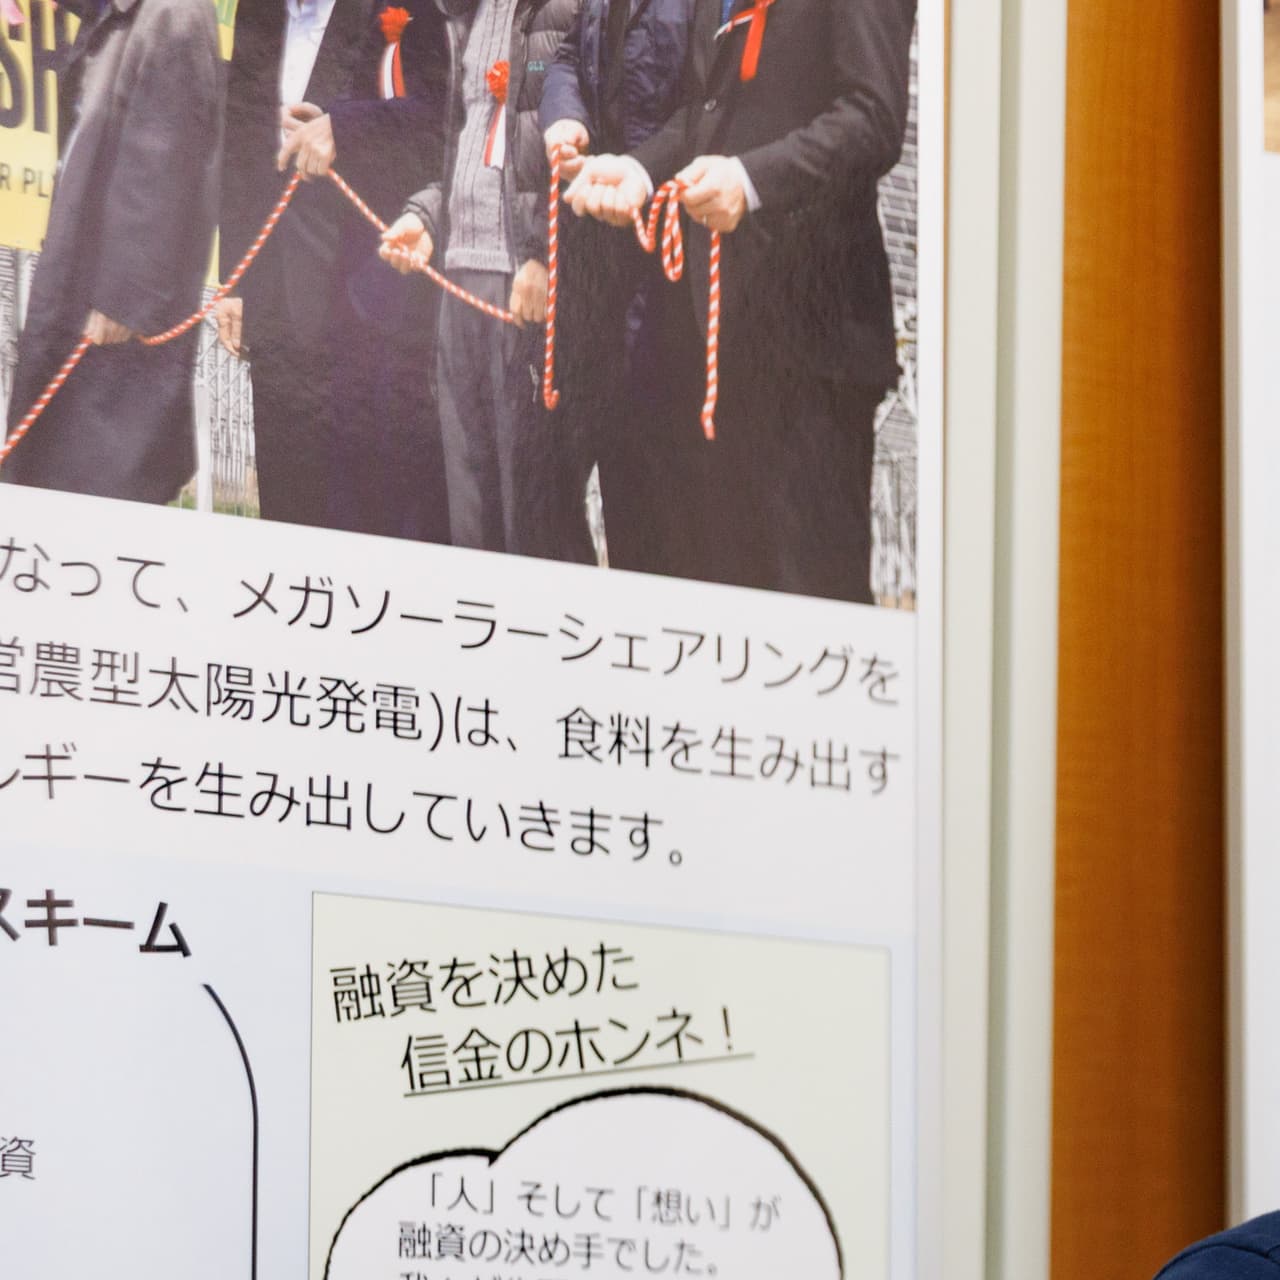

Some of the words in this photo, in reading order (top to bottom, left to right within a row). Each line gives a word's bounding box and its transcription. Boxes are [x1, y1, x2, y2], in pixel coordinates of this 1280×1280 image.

[329, 941, 640, 1023] 融資を決めた
[397, 1221, 719, 1278] 融資の決め手でした。
